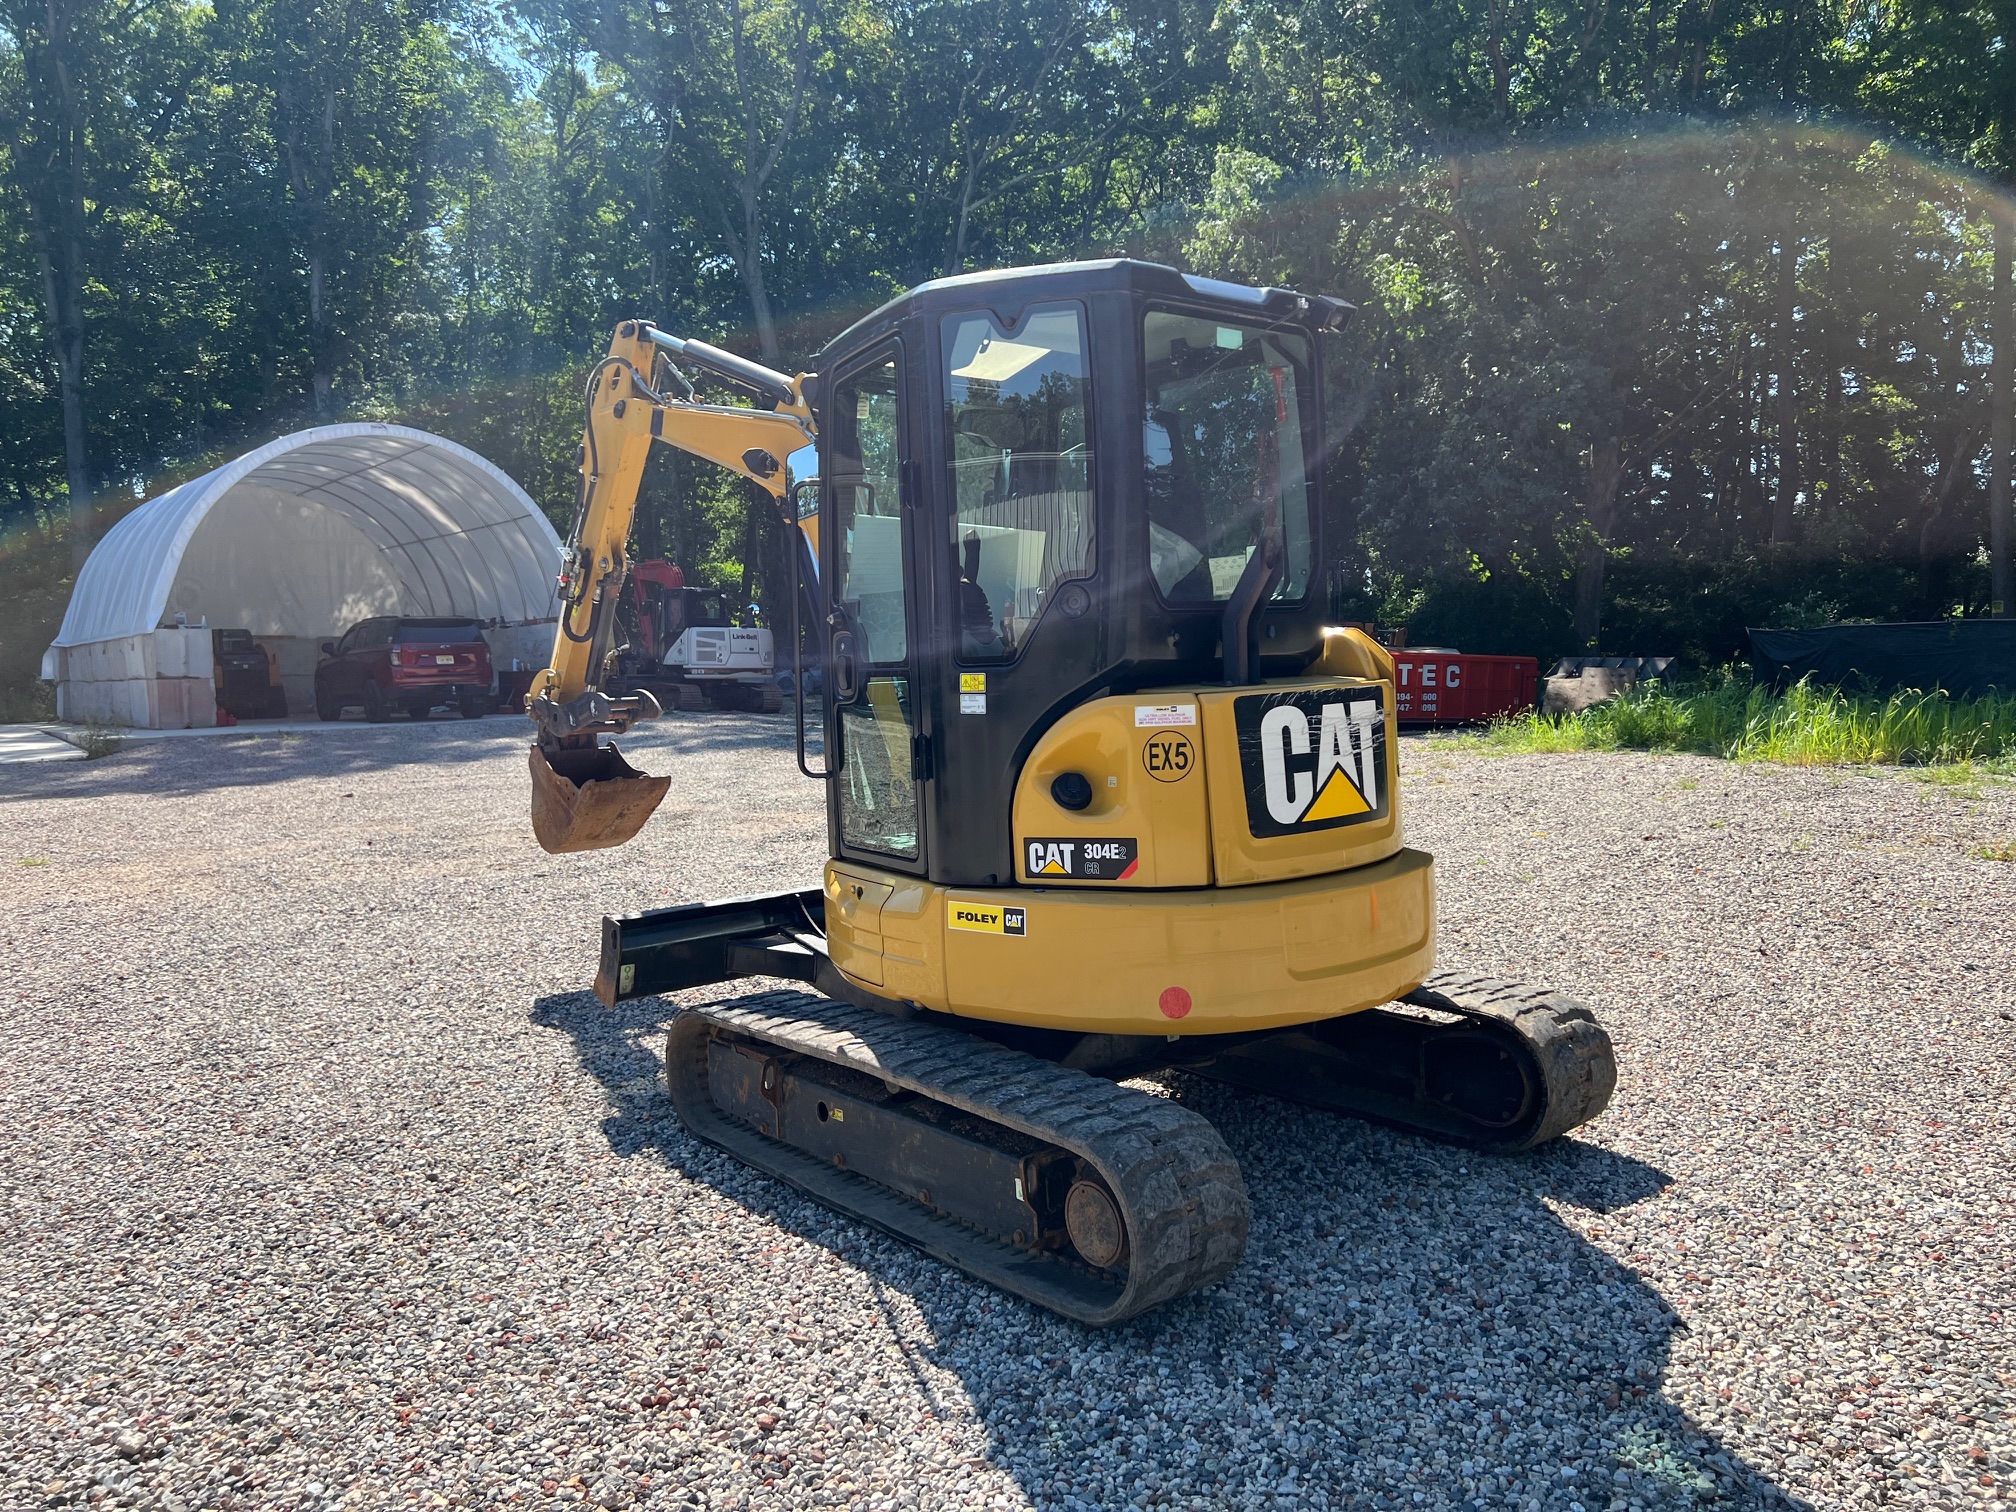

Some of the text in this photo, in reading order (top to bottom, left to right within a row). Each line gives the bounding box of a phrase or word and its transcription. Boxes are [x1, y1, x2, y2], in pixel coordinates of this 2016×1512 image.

[1149, 742, 1188, 771] EX5
[1261, 700, 1377, 824] CAT
[1029, 843, 1126, 873] CAT 304E2
[1084, 862, 1099, 874] CR
[957, 911, 1023, 927] FOLEY CAT
